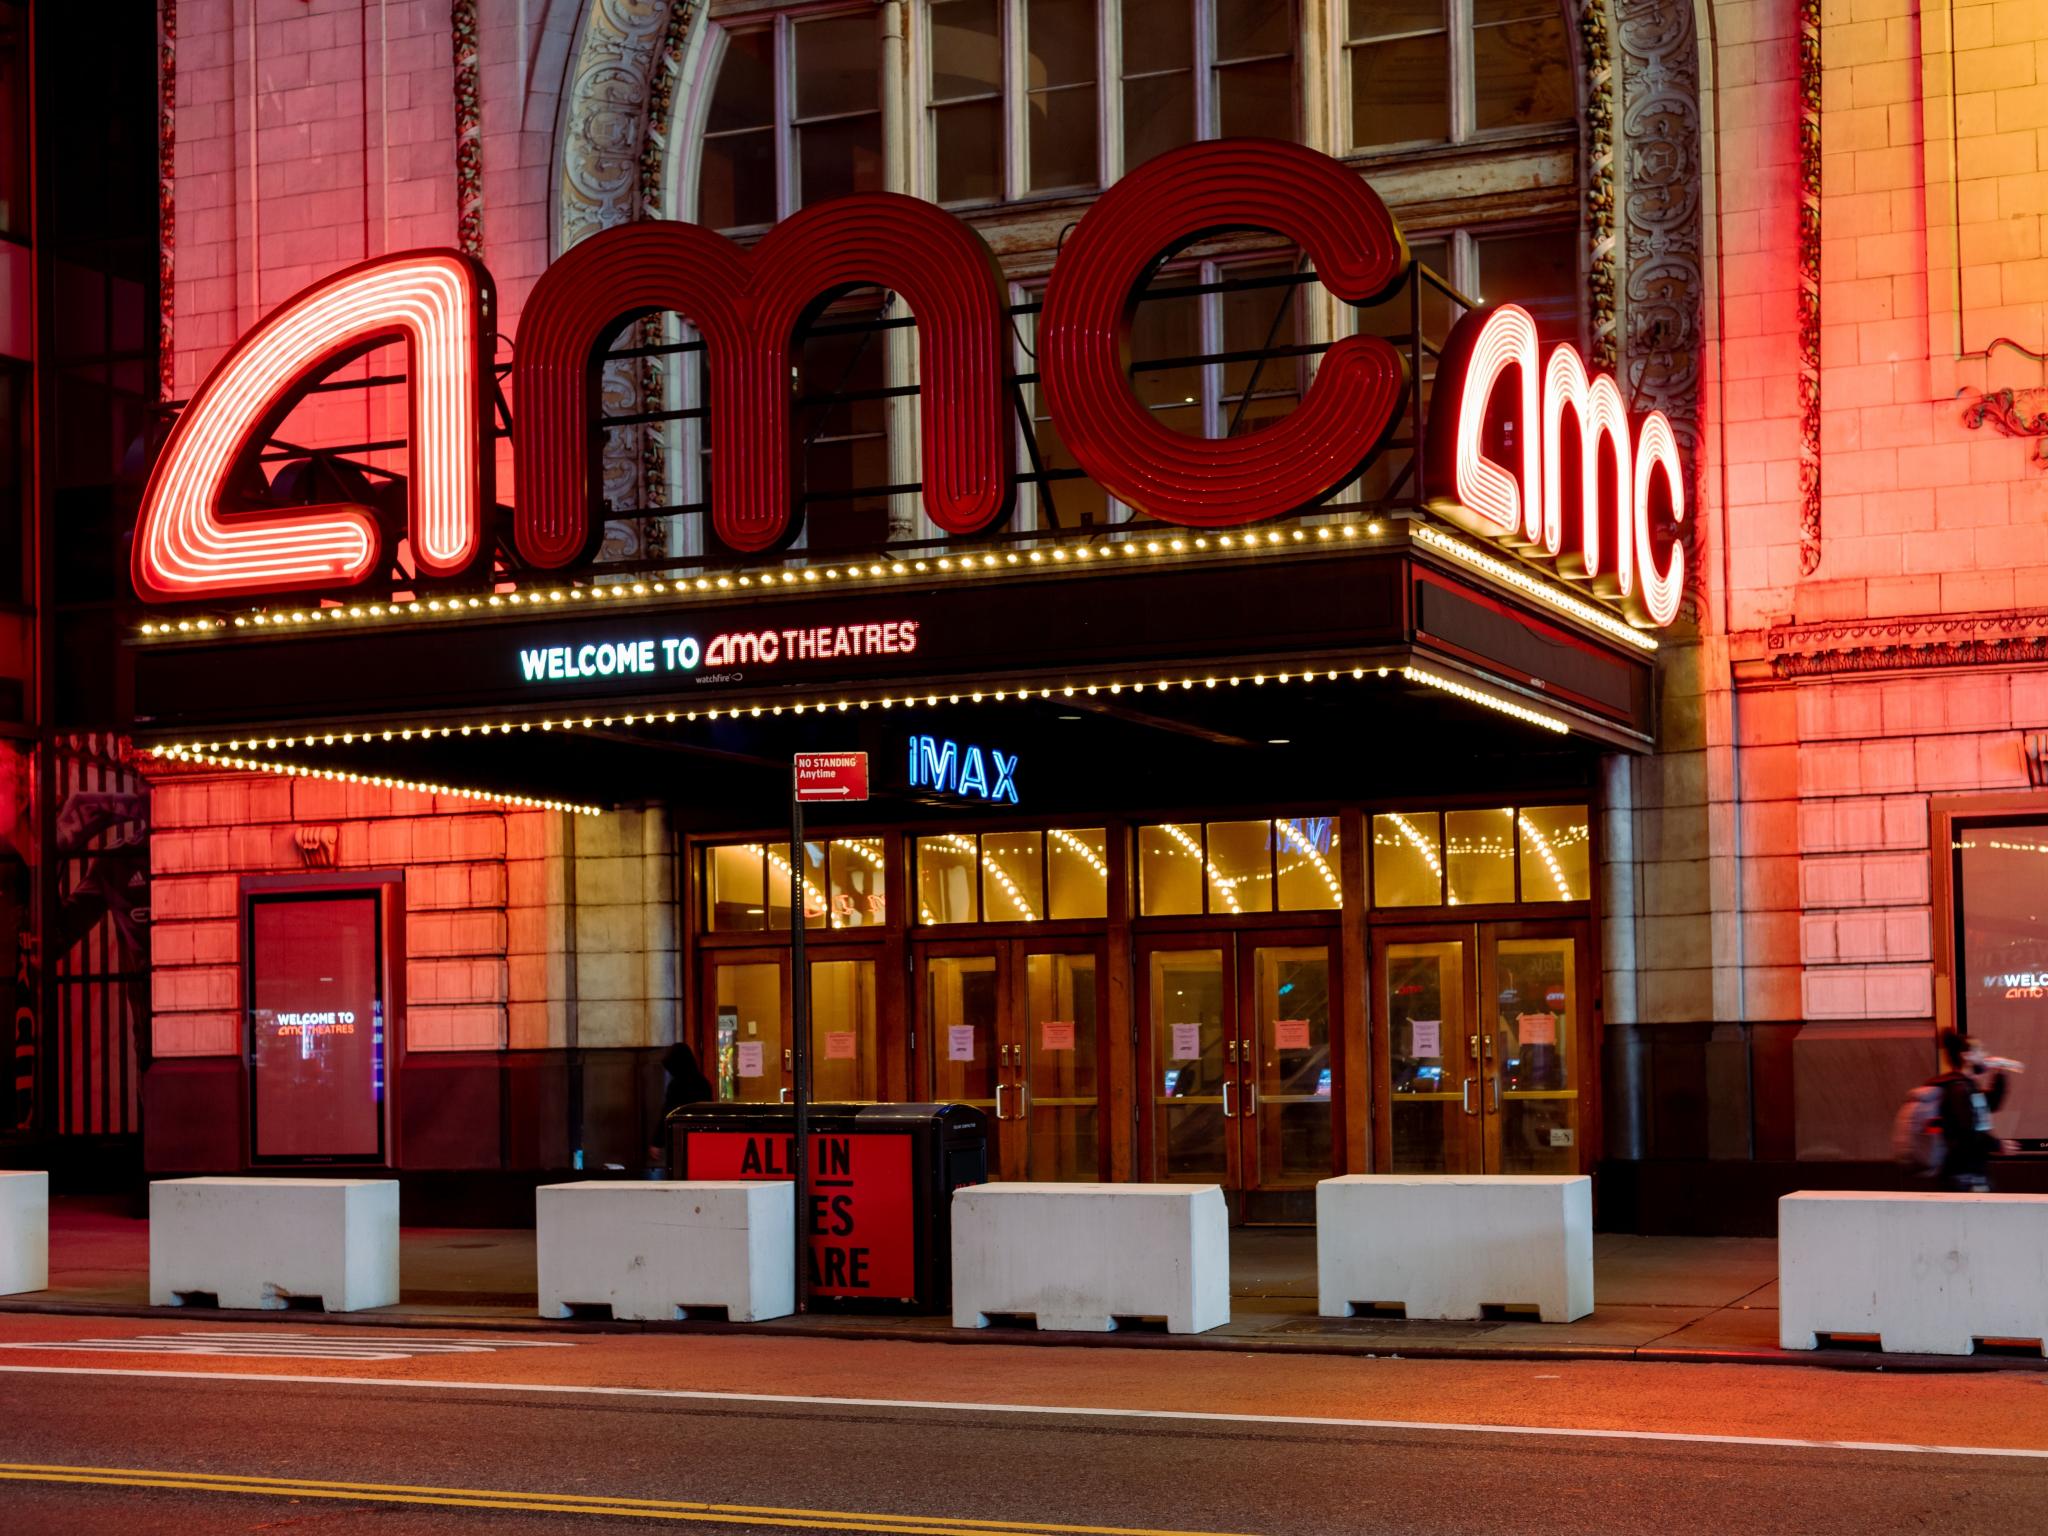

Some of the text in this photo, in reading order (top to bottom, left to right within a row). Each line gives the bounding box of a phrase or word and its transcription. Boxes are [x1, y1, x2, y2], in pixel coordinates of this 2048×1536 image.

[520, 639, 655, 680] WELCOME
[662, 637, 699, 669] TO
[782, 621, 917, 659] THEATRES
[695, 674, 730, 684] watchfire
[799, 757, 856, 767] NO STANDING
[799, 769, 836, 780] Anytime
[277, 1012, 354, 1025] WELCOME TO
[306, 1024, 354, 1035] THEATRES
[818, 1138, 850, 1175] IN
[808, 1195, 854, 1237] ES
[808, 1247, 870, 1289] ARE
